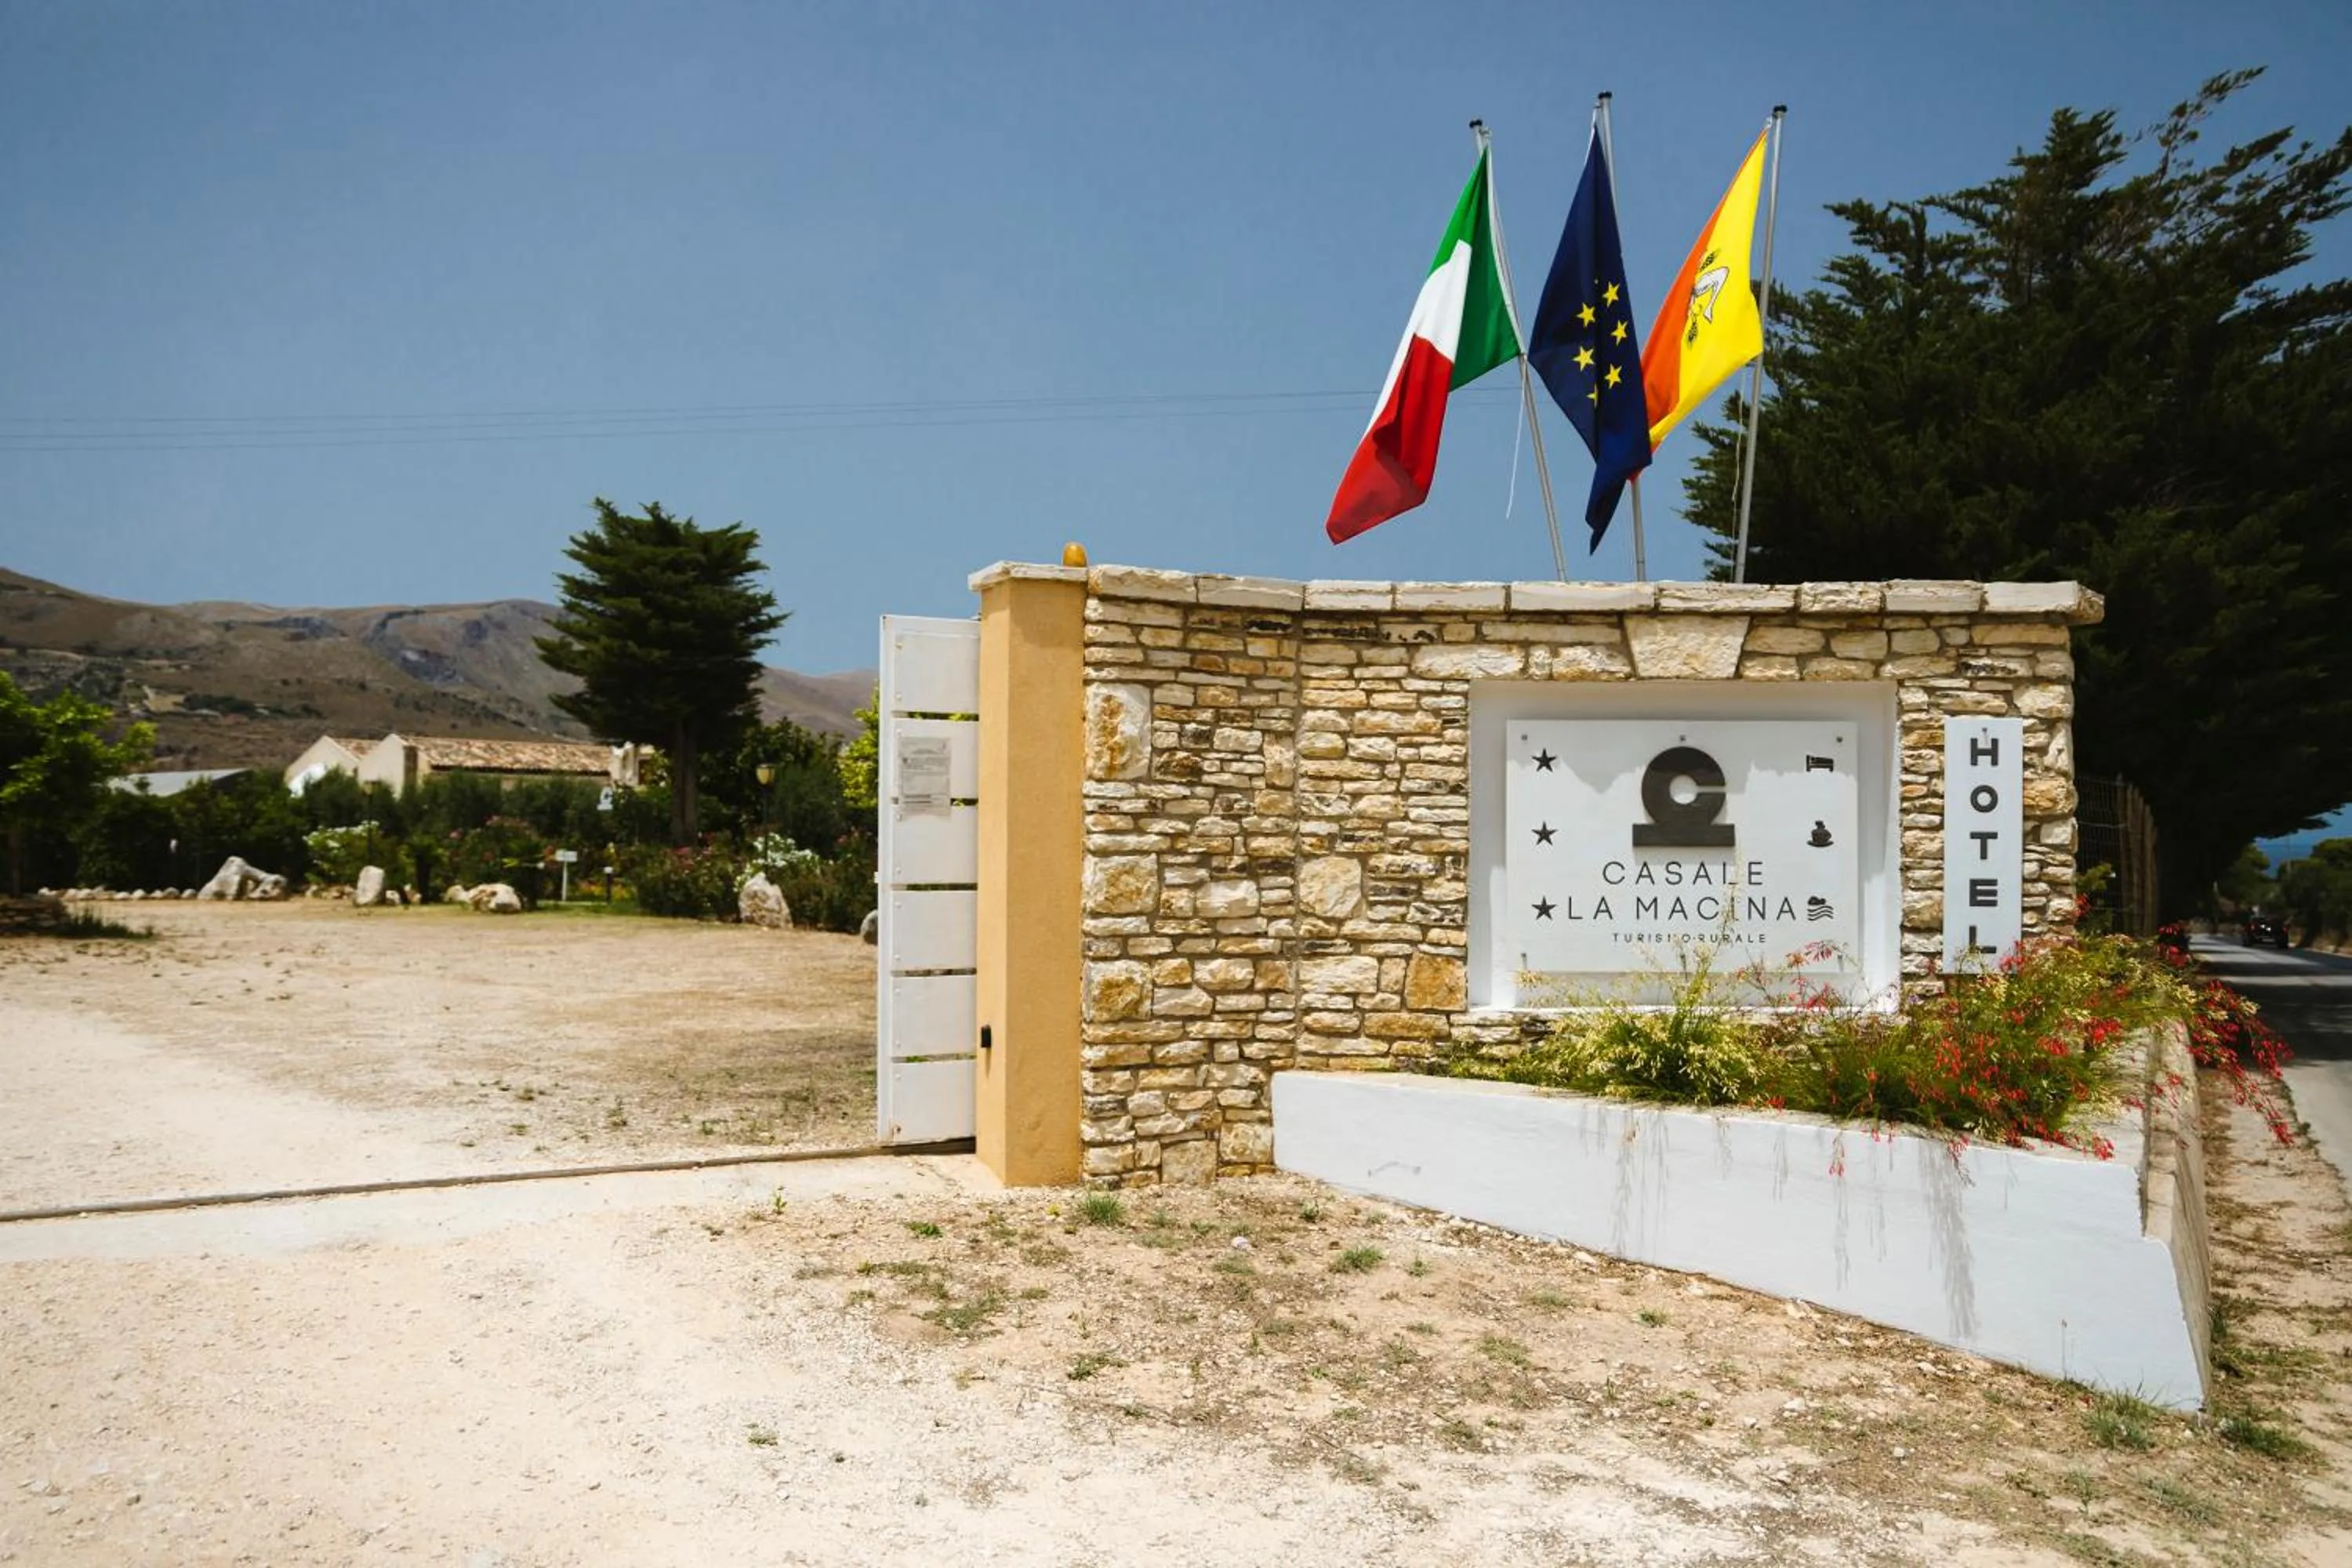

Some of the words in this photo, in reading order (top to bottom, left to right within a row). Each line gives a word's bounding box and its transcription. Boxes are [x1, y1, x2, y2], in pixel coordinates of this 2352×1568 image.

[1969, 738, 1998, 954] HOTEL
[1602, 862, 1763, 885] CASALE
[1568, 896, 1613, 920] LA
